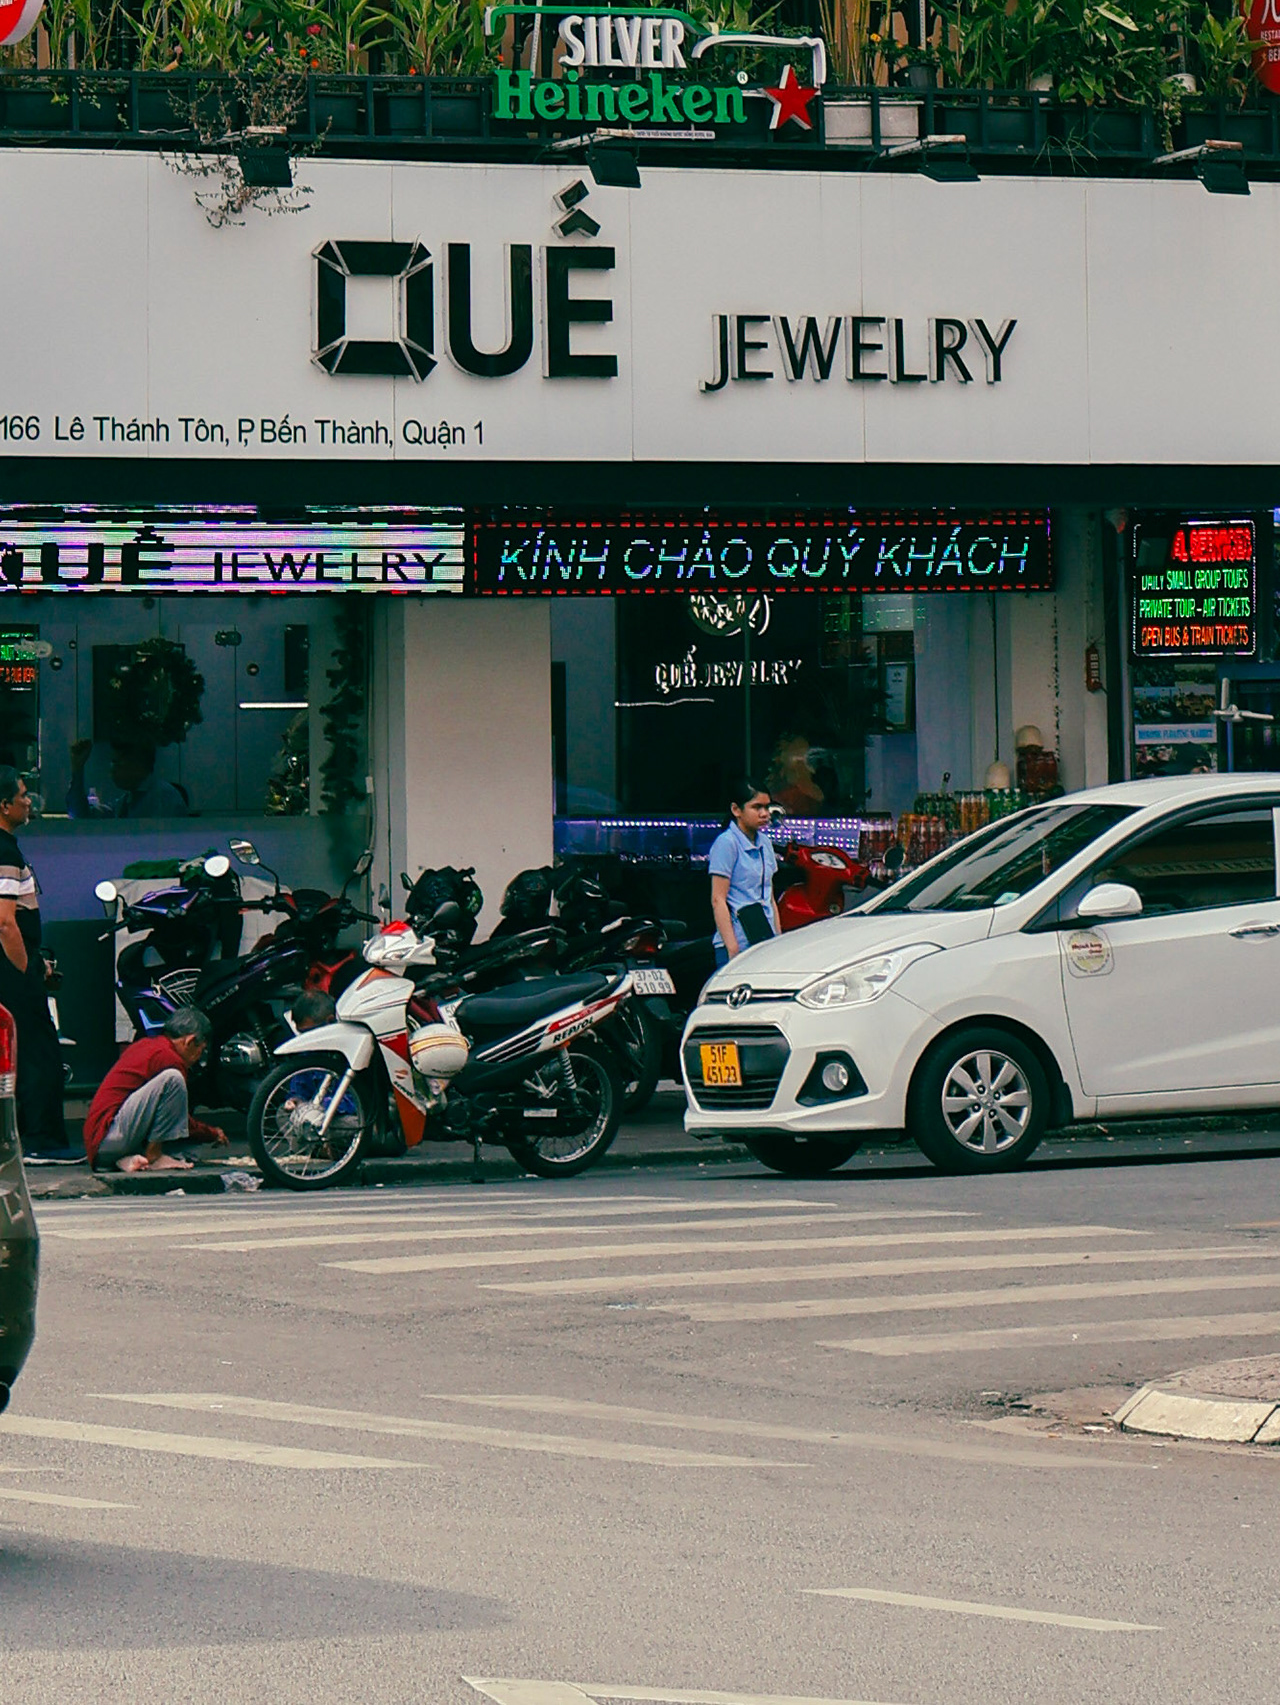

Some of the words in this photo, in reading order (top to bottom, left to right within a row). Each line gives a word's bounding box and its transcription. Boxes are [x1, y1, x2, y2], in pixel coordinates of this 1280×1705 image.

[558, 15, 687, 68] SILVER
[493, 69, 748, 123] Heineken
[312, 179, 618, 383] QUẾ
[700, 313, 1018, 394] JEWELRY
[54, 417, 85, 441] Lê
[93, 416, 170, 442] Thánh
[178, 417, 229, 446] Tôn,
[260, 413, 307, 444] Bến
[314, 419, 394, 448] Thành,
[402, 420, 465, 449] Quận
[474, 421, 484, 445] 1
[498, 531, 610, 580] KÍNH
[623, 530, 753, 579] CHÀO
[767, 527, 859, 578] QUÝ
[876, 526, 1029, 578] KHÁCH
[1195, 569, 1221, 589] GROUP
[711, 1046, 727, 1063] 51F
